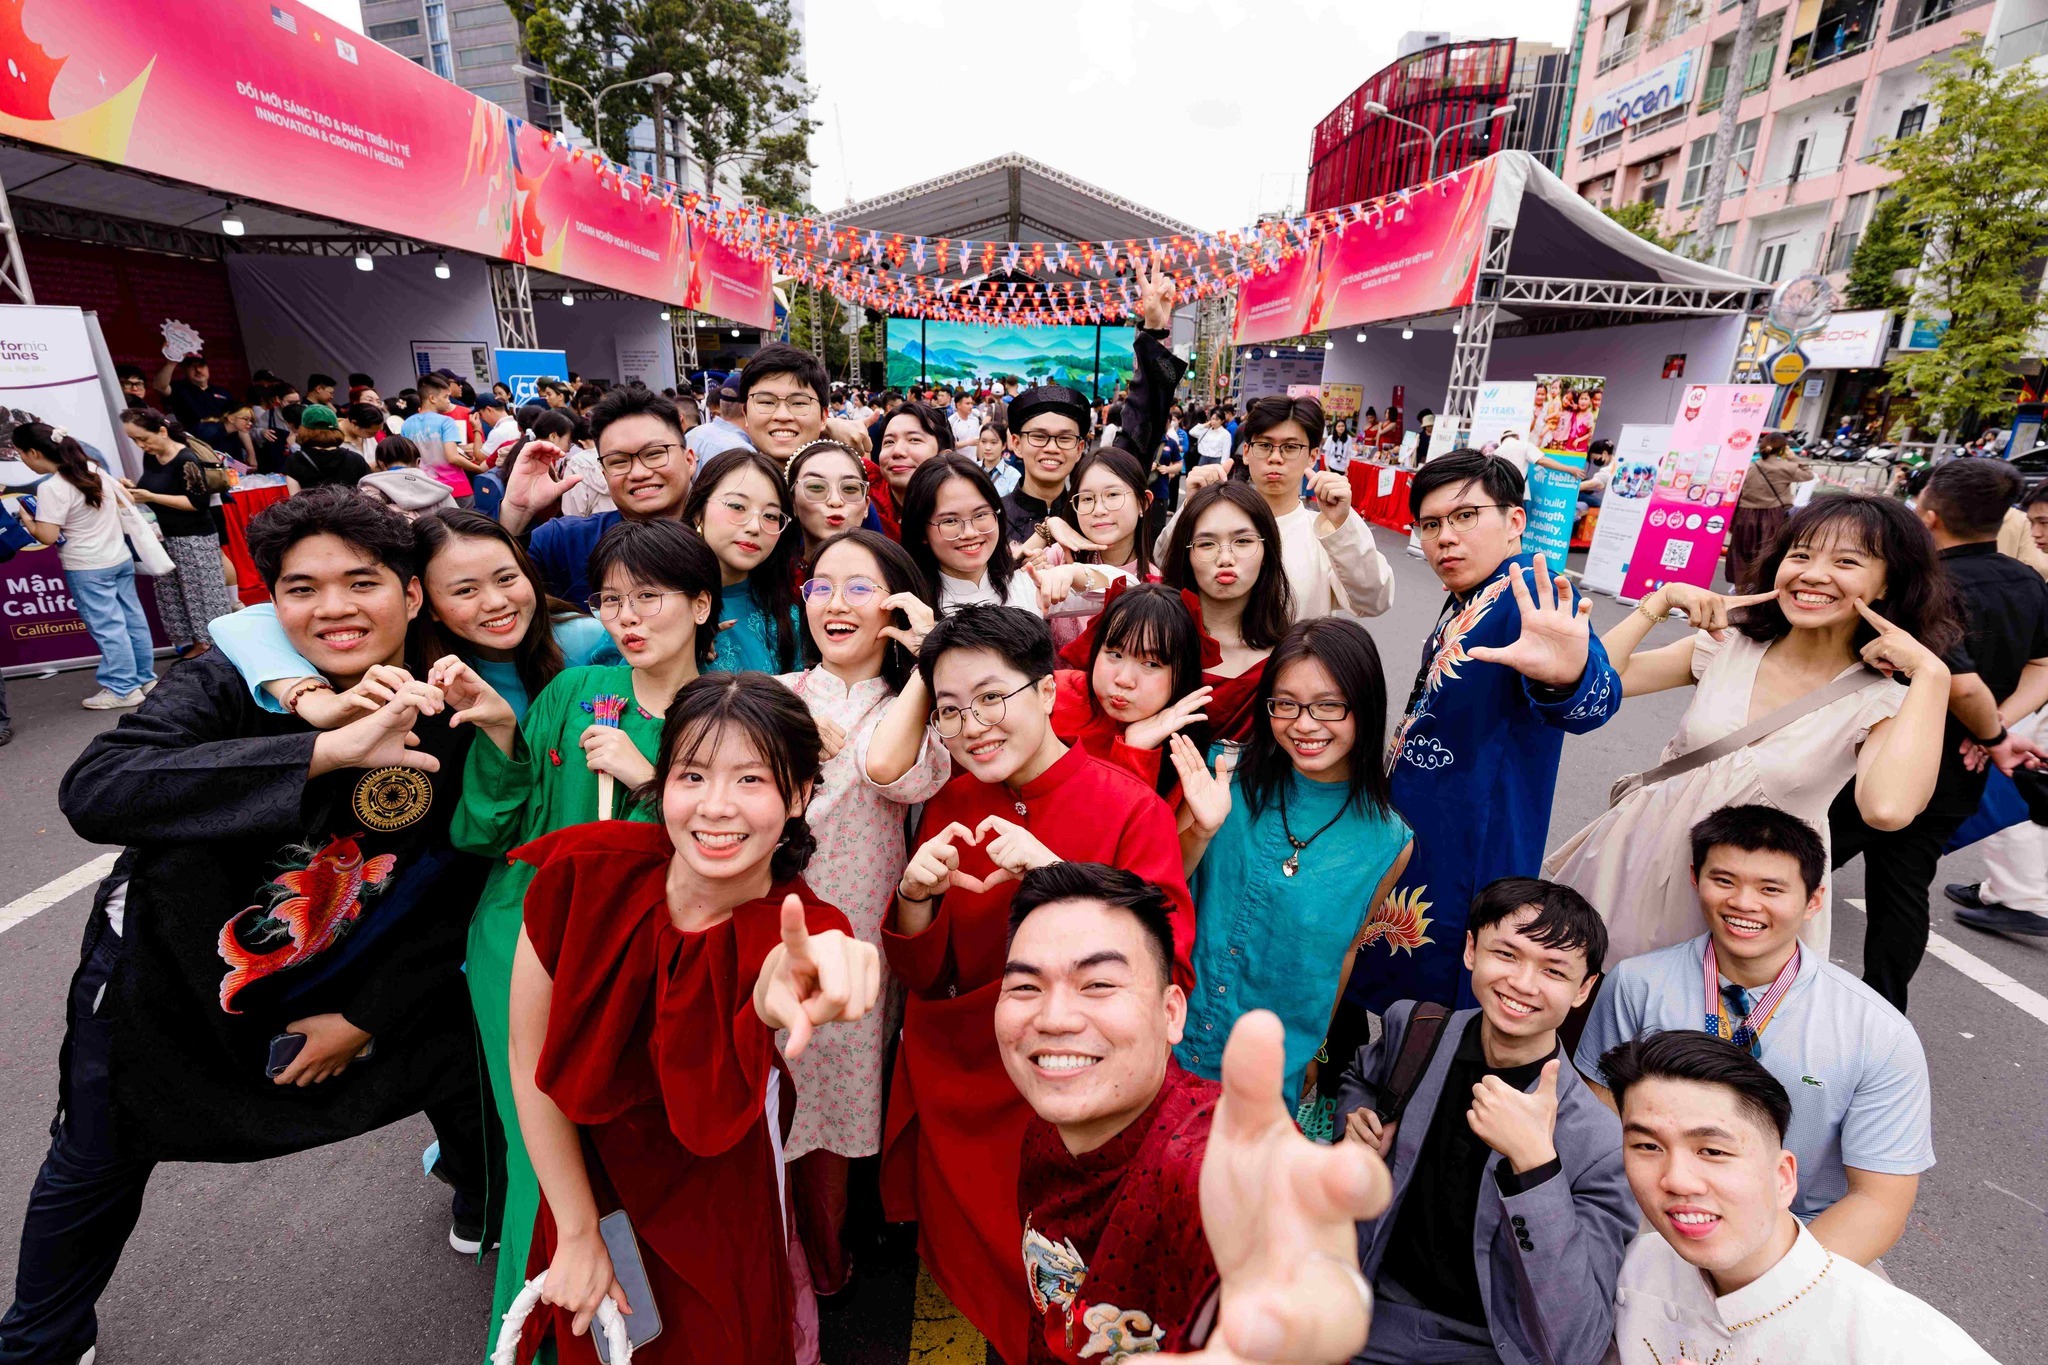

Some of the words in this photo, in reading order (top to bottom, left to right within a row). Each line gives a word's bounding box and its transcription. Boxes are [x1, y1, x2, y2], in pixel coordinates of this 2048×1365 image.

[236, 80, 259, 101] ĐỔI
[260, 90, 283, 110] MỚI
[283, 99, 313, 121] SÁNG
[312, 110, 333, 128] TẠO
[333, 119, 341, 132] &
[342, 121, 364, 141] PHÁT
[364, 131, 390, 150] TRIỂN
[400, 144, 411, 158] TẾ
[255, 105, 320, 140] INNOVATION
[321, 130, 329, 143] &
[329, 133, 369, 157] GROWTH
[373, 149, 405, 169] HEALTH
[0, 340, 48, 352] fornia
[0, 352, 39, 361] unes
[518, 382, 540, 398] CD
[1543, 496, 1567, 509] build
[1531, 508, 1566, 523] strength,
[1530, 520, 1562, 536] stability,
[6, 574, 65, 597] Mận
[3, 595, 78, 617] Califo
[16, 620, 87, 637] California
